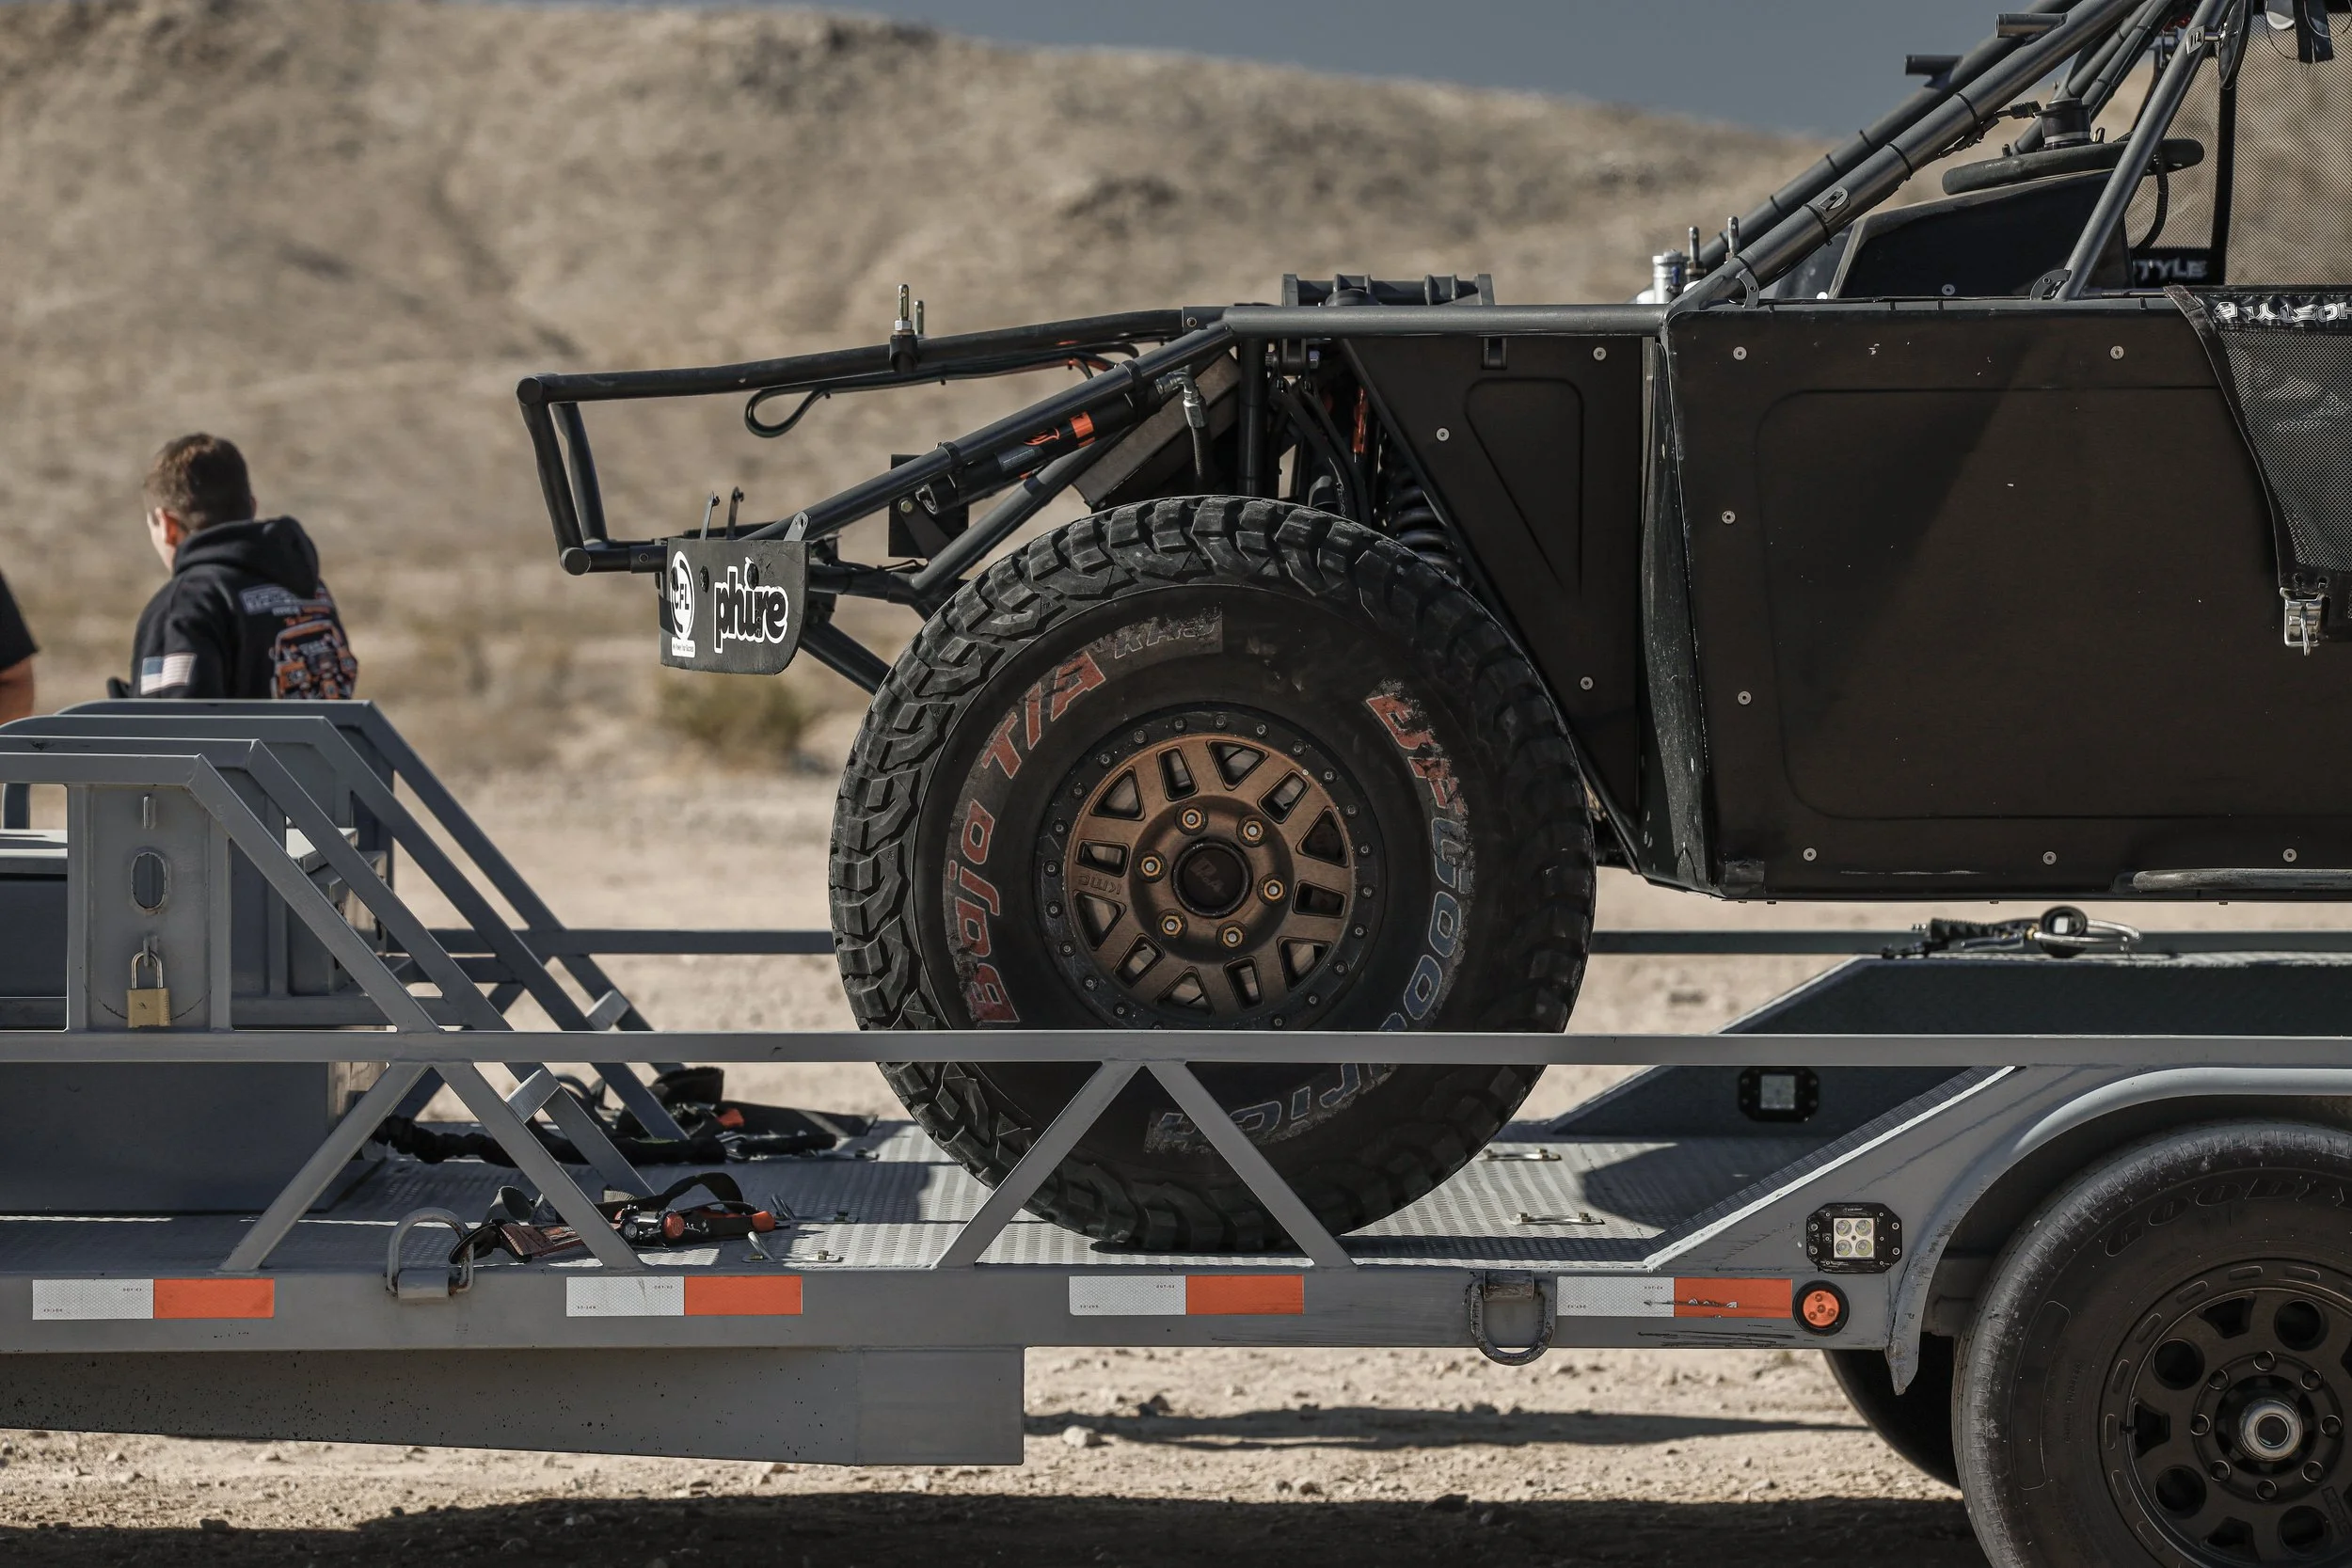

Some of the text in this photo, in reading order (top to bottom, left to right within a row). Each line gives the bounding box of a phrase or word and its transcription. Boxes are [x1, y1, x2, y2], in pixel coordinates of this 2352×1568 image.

[2132, 256, 2209, 280] TYLE
[714, 562, 788, 654] phire
[981, 650, 1106, 780] T/A
[947, 799, 1019, 1023] Baja
